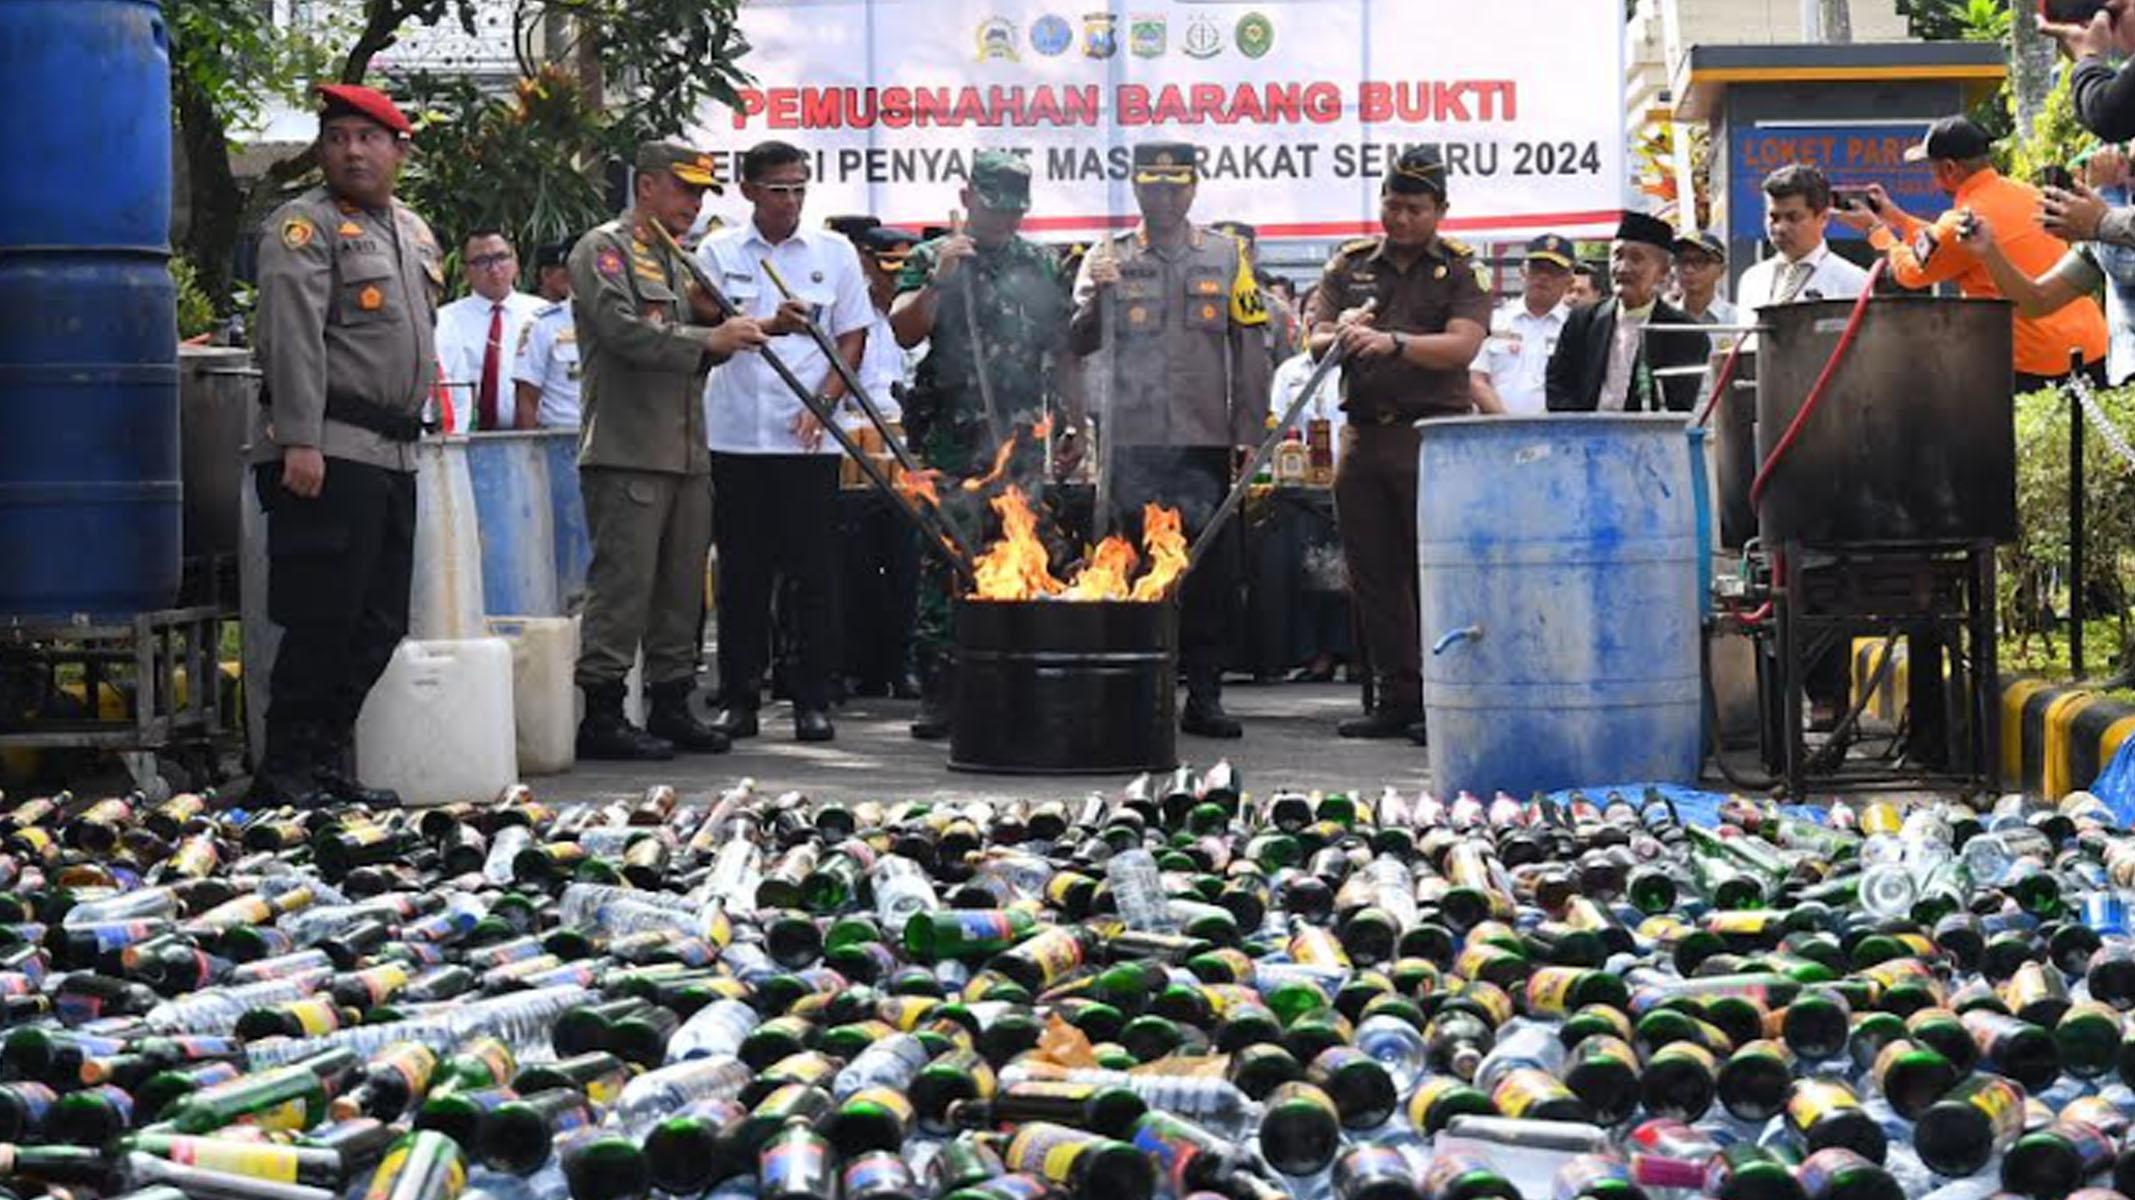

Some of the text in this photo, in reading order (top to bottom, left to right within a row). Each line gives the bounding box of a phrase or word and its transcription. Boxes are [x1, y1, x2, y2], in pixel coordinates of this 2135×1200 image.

[732, 80, 1517, 130] PEMUSNAHAN BARANG BUKTI
[1049, 145, 1319, 181] MASRAKAT
[1333, 142, 1498, 178] SEMRU
[1513, 140, 1601, 176] 2024
